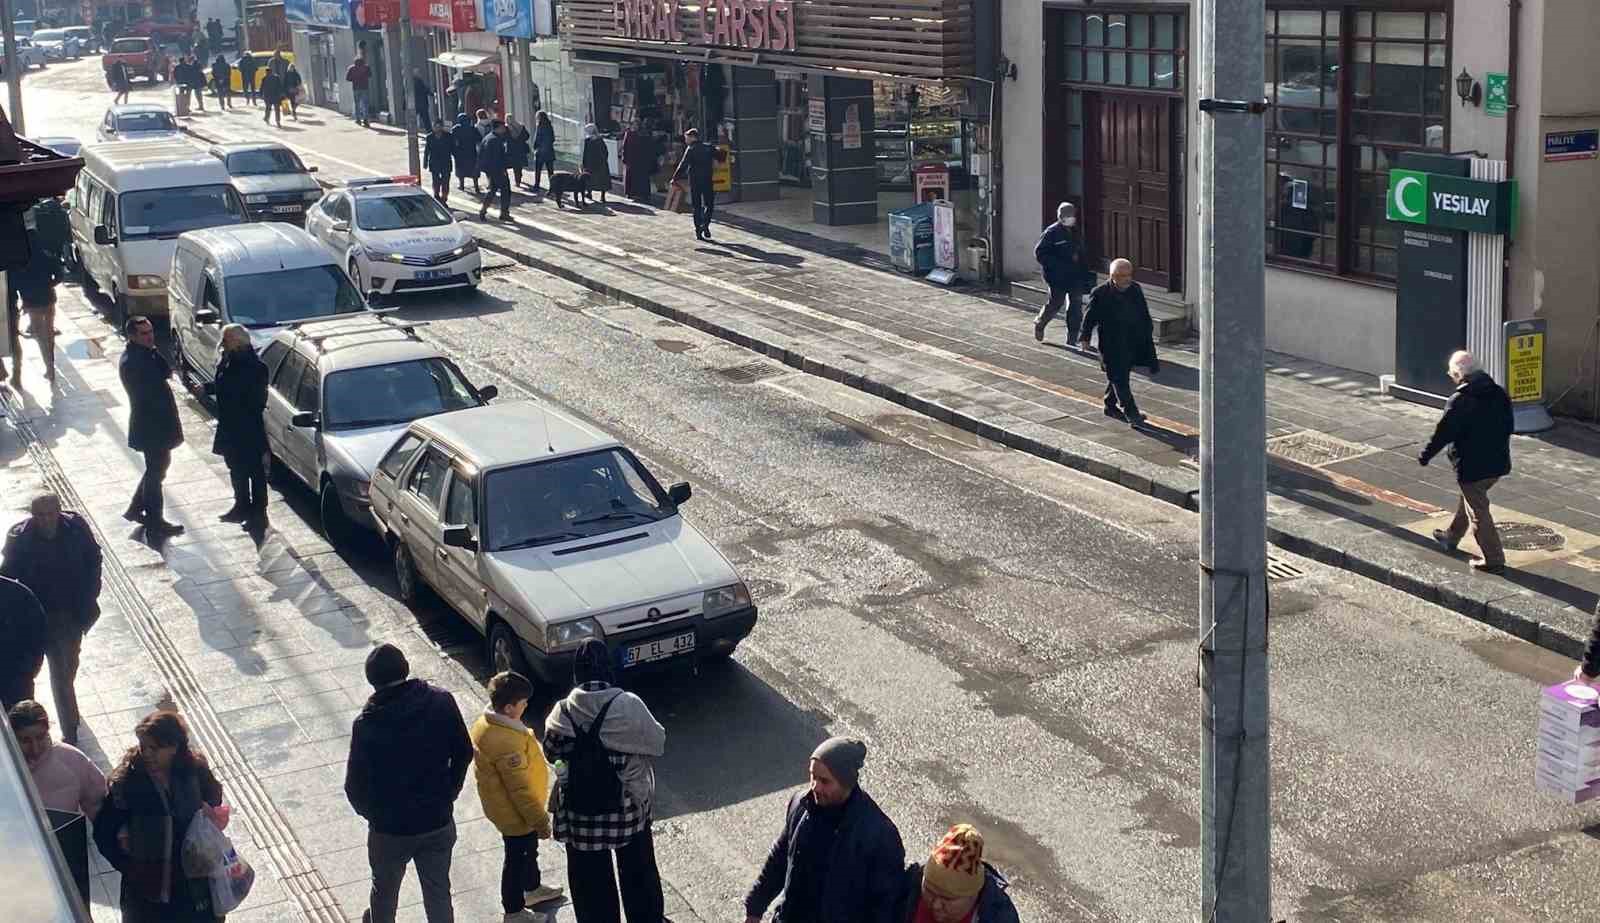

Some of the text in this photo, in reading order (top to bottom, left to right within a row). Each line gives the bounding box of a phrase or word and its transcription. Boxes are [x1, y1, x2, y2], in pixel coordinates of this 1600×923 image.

[628, 634, 694, 662] 67 EL 432
